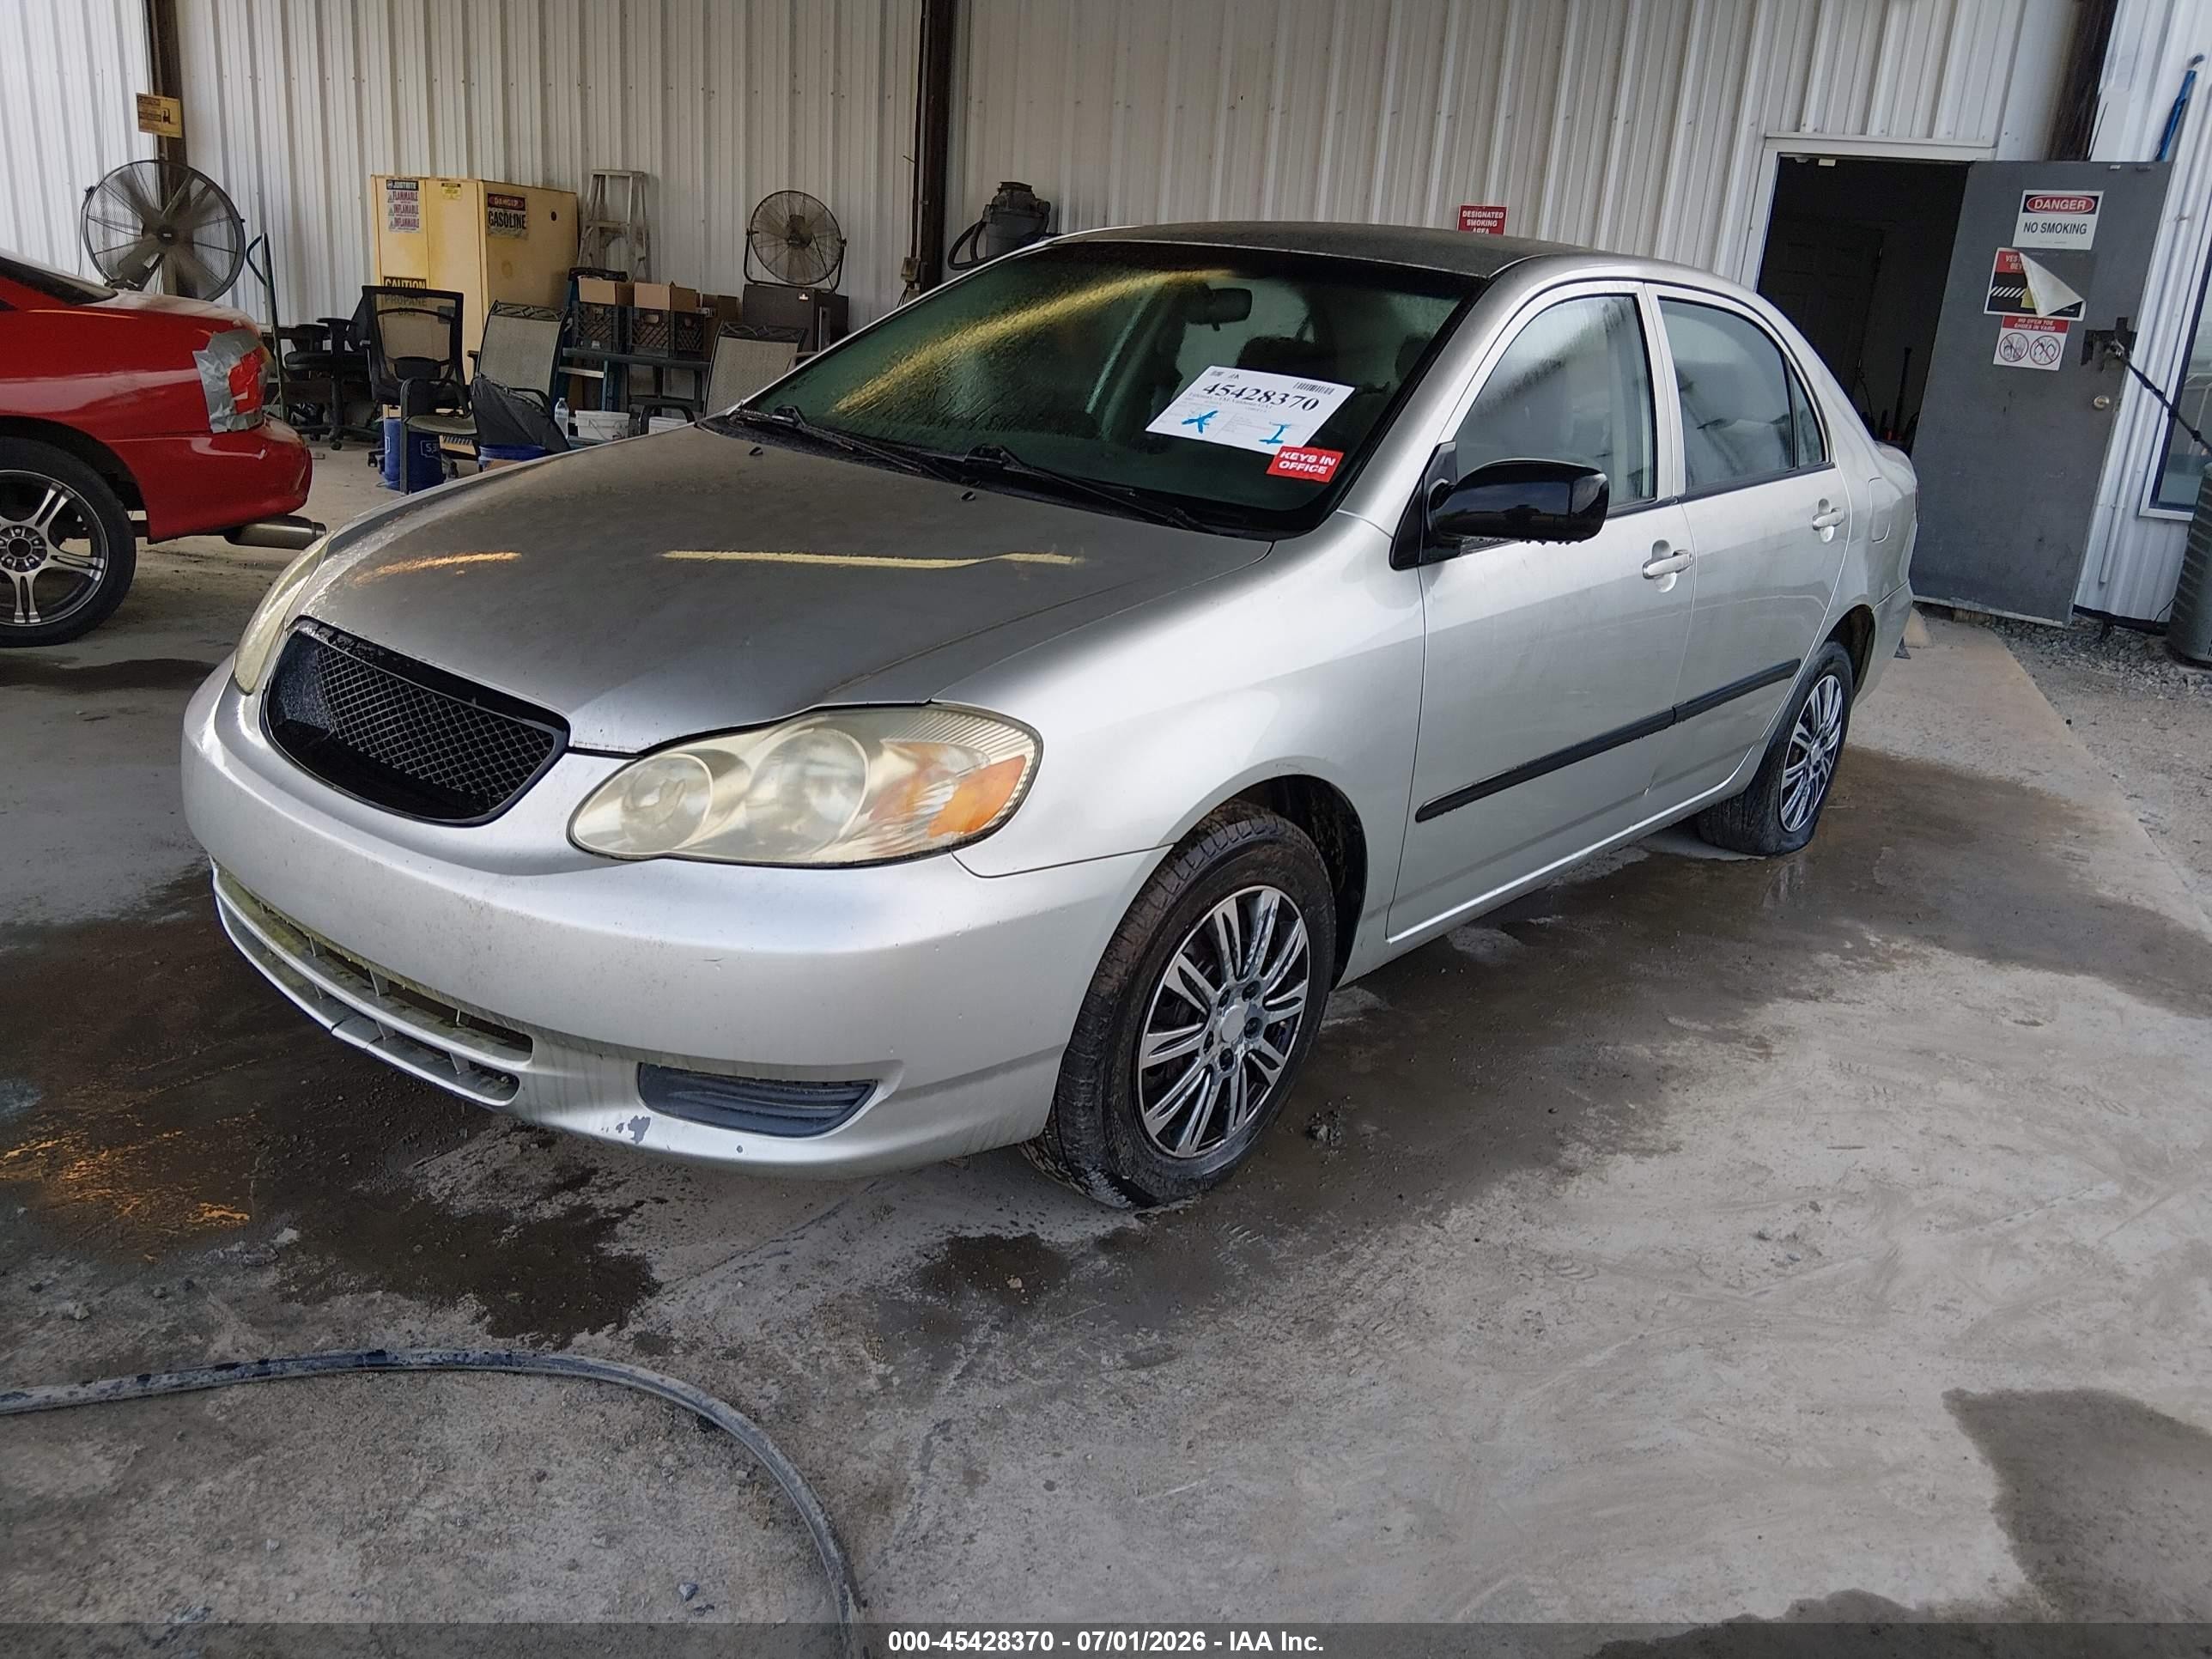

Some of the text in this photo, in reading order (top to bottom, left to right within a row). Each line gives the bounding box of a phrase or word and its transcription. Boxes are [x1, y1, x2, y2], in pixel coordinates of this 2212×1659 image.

[2033, 198, 2087, 210] DANGER
[488, 211, 526, 230] GASOLINE
[1462, 210, 1504, 219] DESIGNATED
[2023, 222, 2087, 234] NO SMOKING
[385, 278, 426, 289] CAUTION
[384, 295, 428, 307] PROPANE
[1202, 382, 1320, 411] 45428370
[1279, 451, 1337, 466] KEYS IN
[1279, 460, 1328, 475] OFFICE
